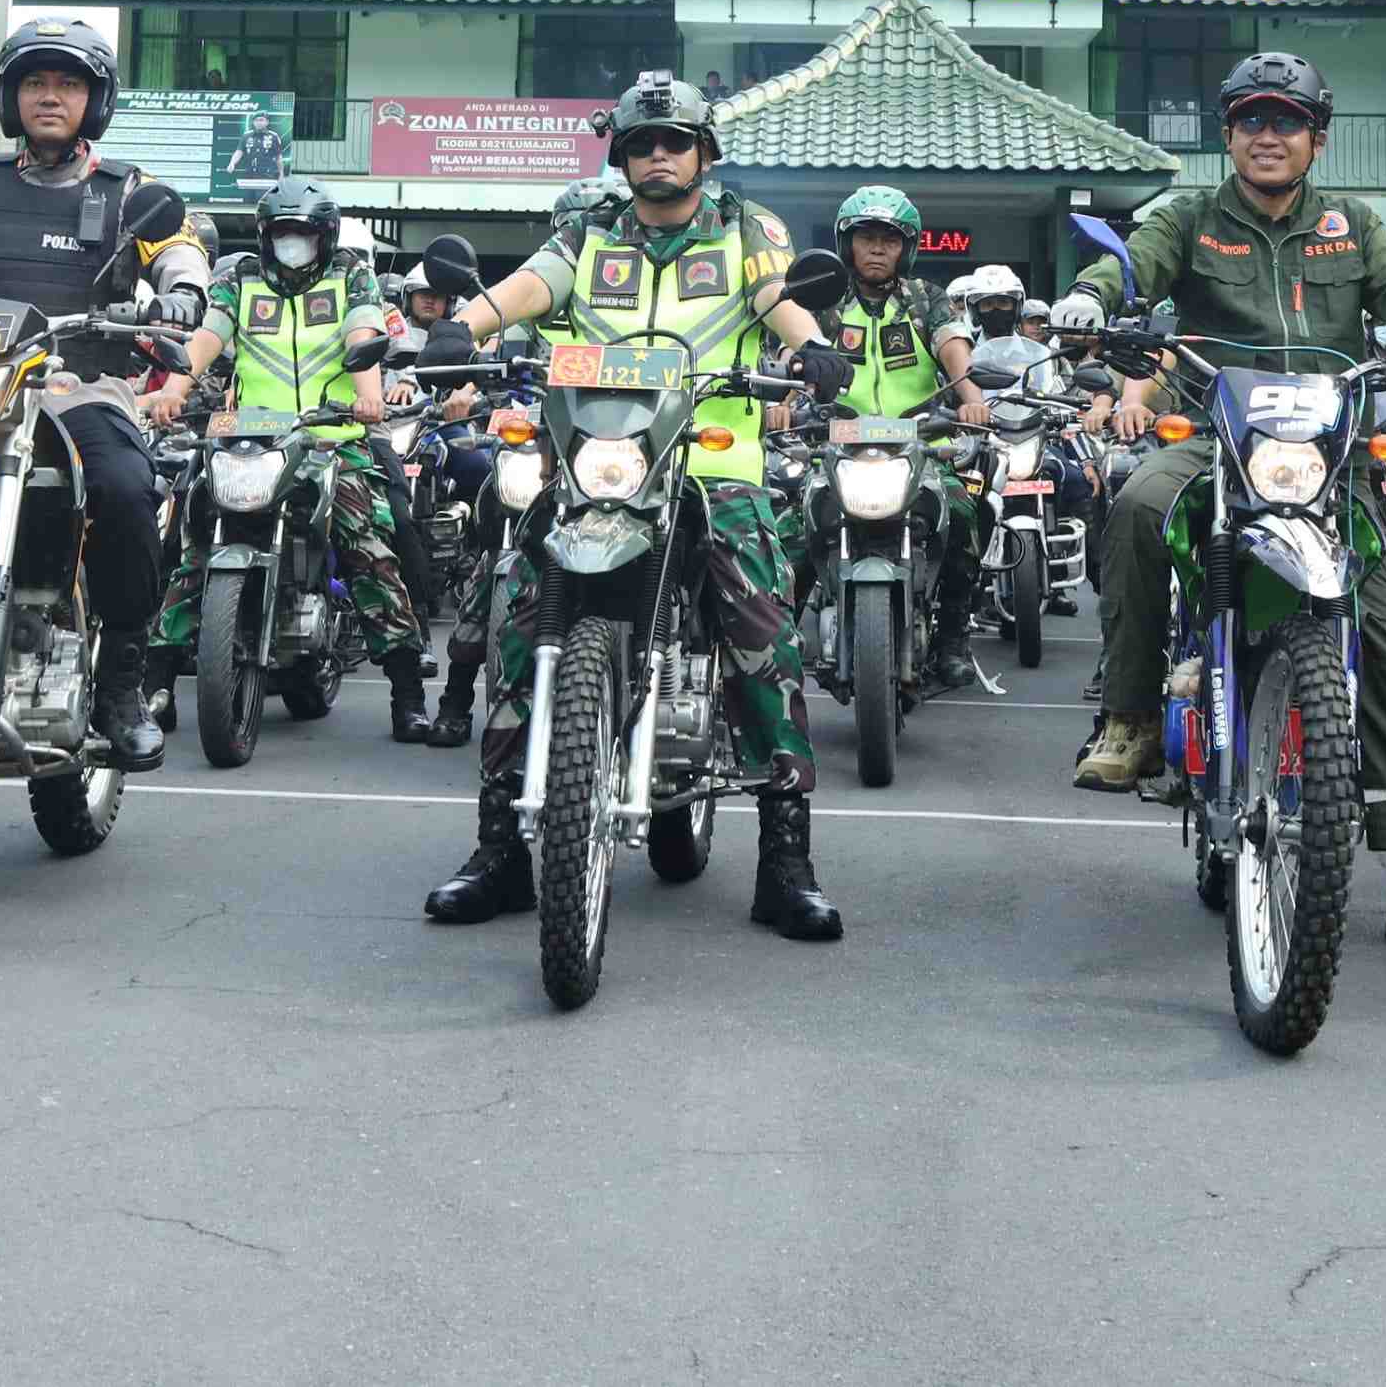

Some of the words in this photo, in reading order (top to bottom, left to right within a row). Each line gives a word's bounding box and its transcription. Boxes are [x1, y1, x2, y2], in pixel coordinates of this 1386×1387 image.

[231, 94, 251, 102] AD
[128, 101, 163, 109] PADA
[167, 101, 221, 110] PEMILU
[464, 103, 493, 112] ANDA
[495, 104, 536, 112] BERADA
[539, 104, 550, 112] DI
[409, 115, 468, 130] ZONA
[476, 116, 595, 132] INTEGRITA
[441, 139, 477, 148] KODIM
[430, 155, 482, 165] WILAYAH
[486, 156, 525, 165] BEBAS
[528, 157, 580, 166] KORUPSI
[1304, 240, 1358, 257] SEKDA
